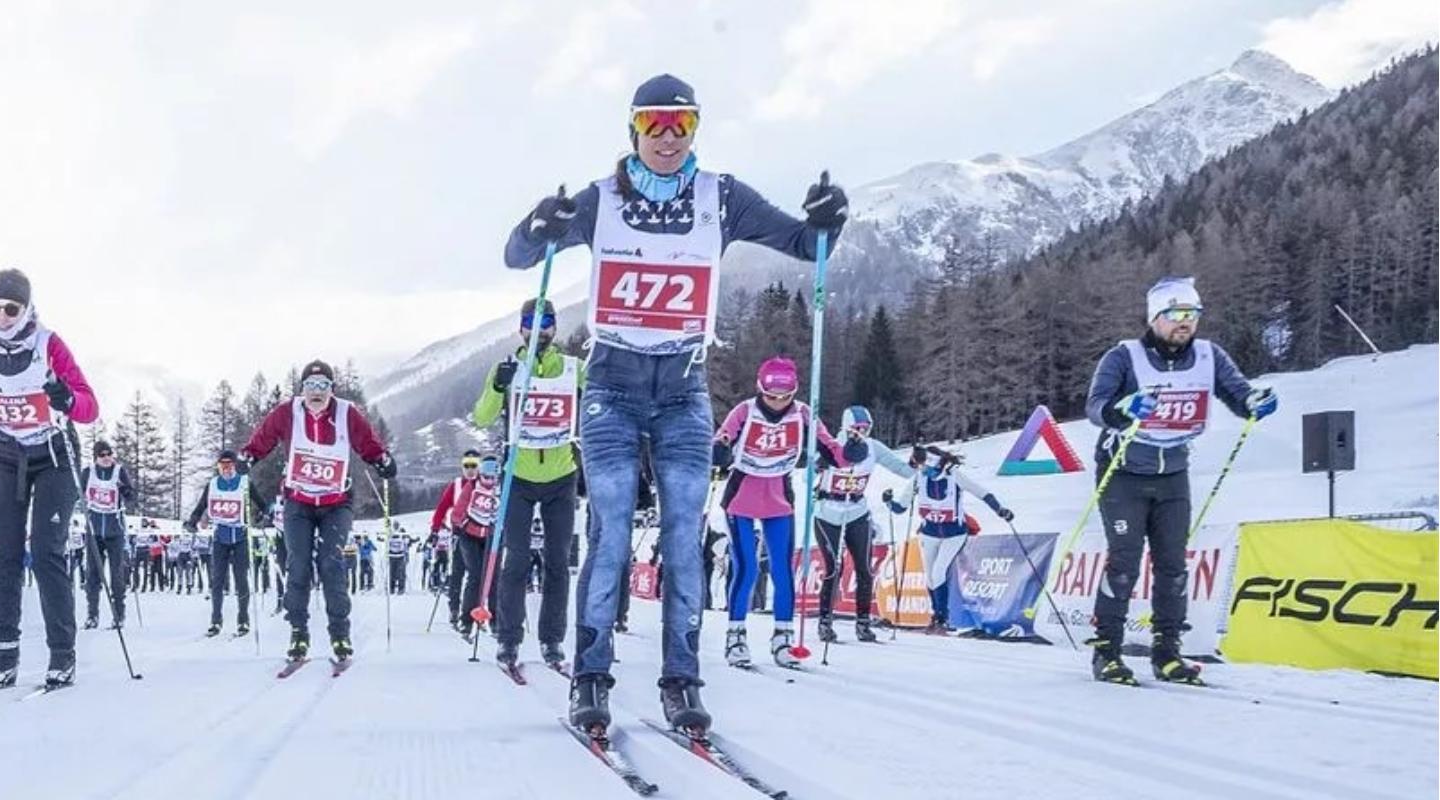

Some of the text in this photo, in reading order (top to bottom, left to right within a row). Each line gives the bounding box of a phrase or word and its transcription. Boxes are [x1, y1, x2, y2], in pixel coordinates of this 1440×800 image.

[610, 271, 696, 312] 472
[524, 397, 565, 418] 473
[1155, 401, 1198, 421] 419
[754, 431, 788, 450] 421
[301, 461, 336, 481] 430
[212, 501, 239, 515] 449
[978, 558, 1014, 576] SPORT
[1230, 576, 1439, 629] FISCH
